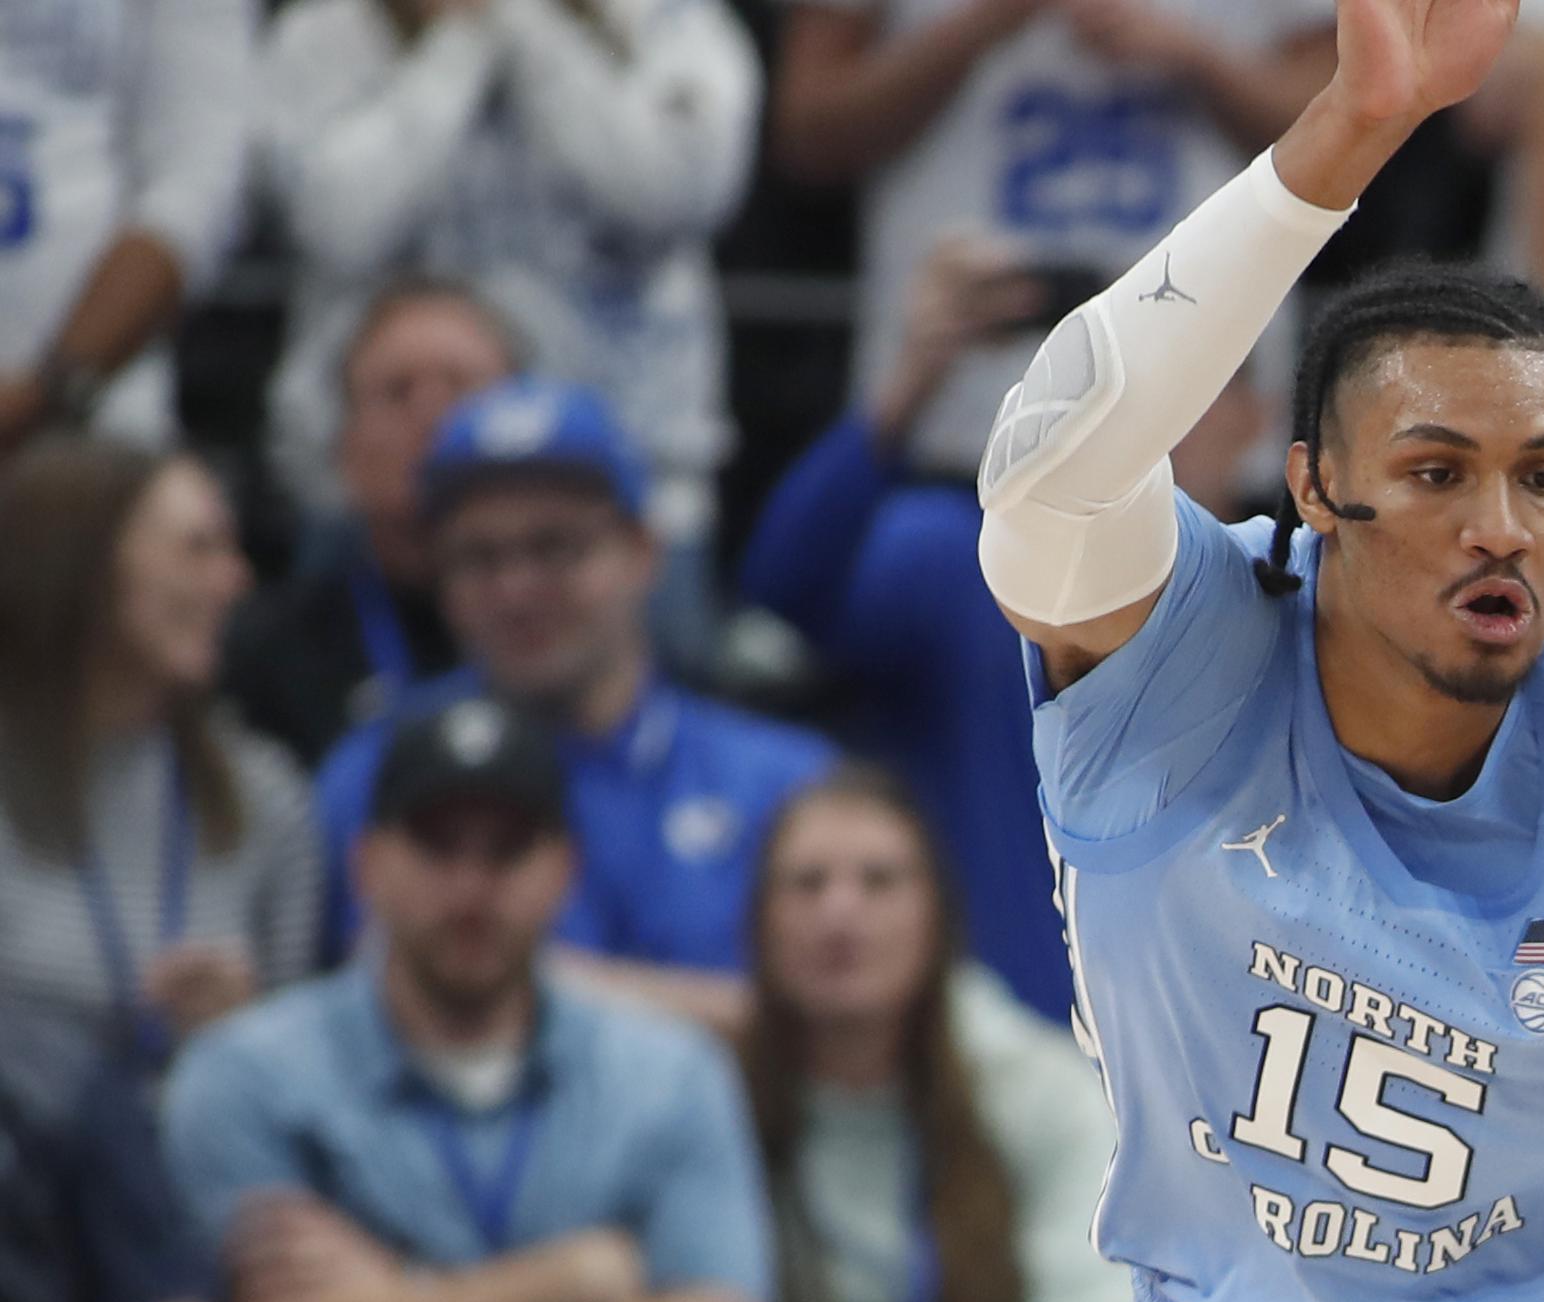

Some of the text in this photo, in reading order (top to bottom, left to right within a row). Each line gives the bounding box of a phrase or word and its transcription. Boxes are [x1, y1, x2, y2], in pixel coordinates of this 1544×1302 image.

[1249, 940, 1497, 1074] NORTH
[1230, 1003, 1488, 1210] 15
[1189, 1116, 1524, 1274] CROLINA
